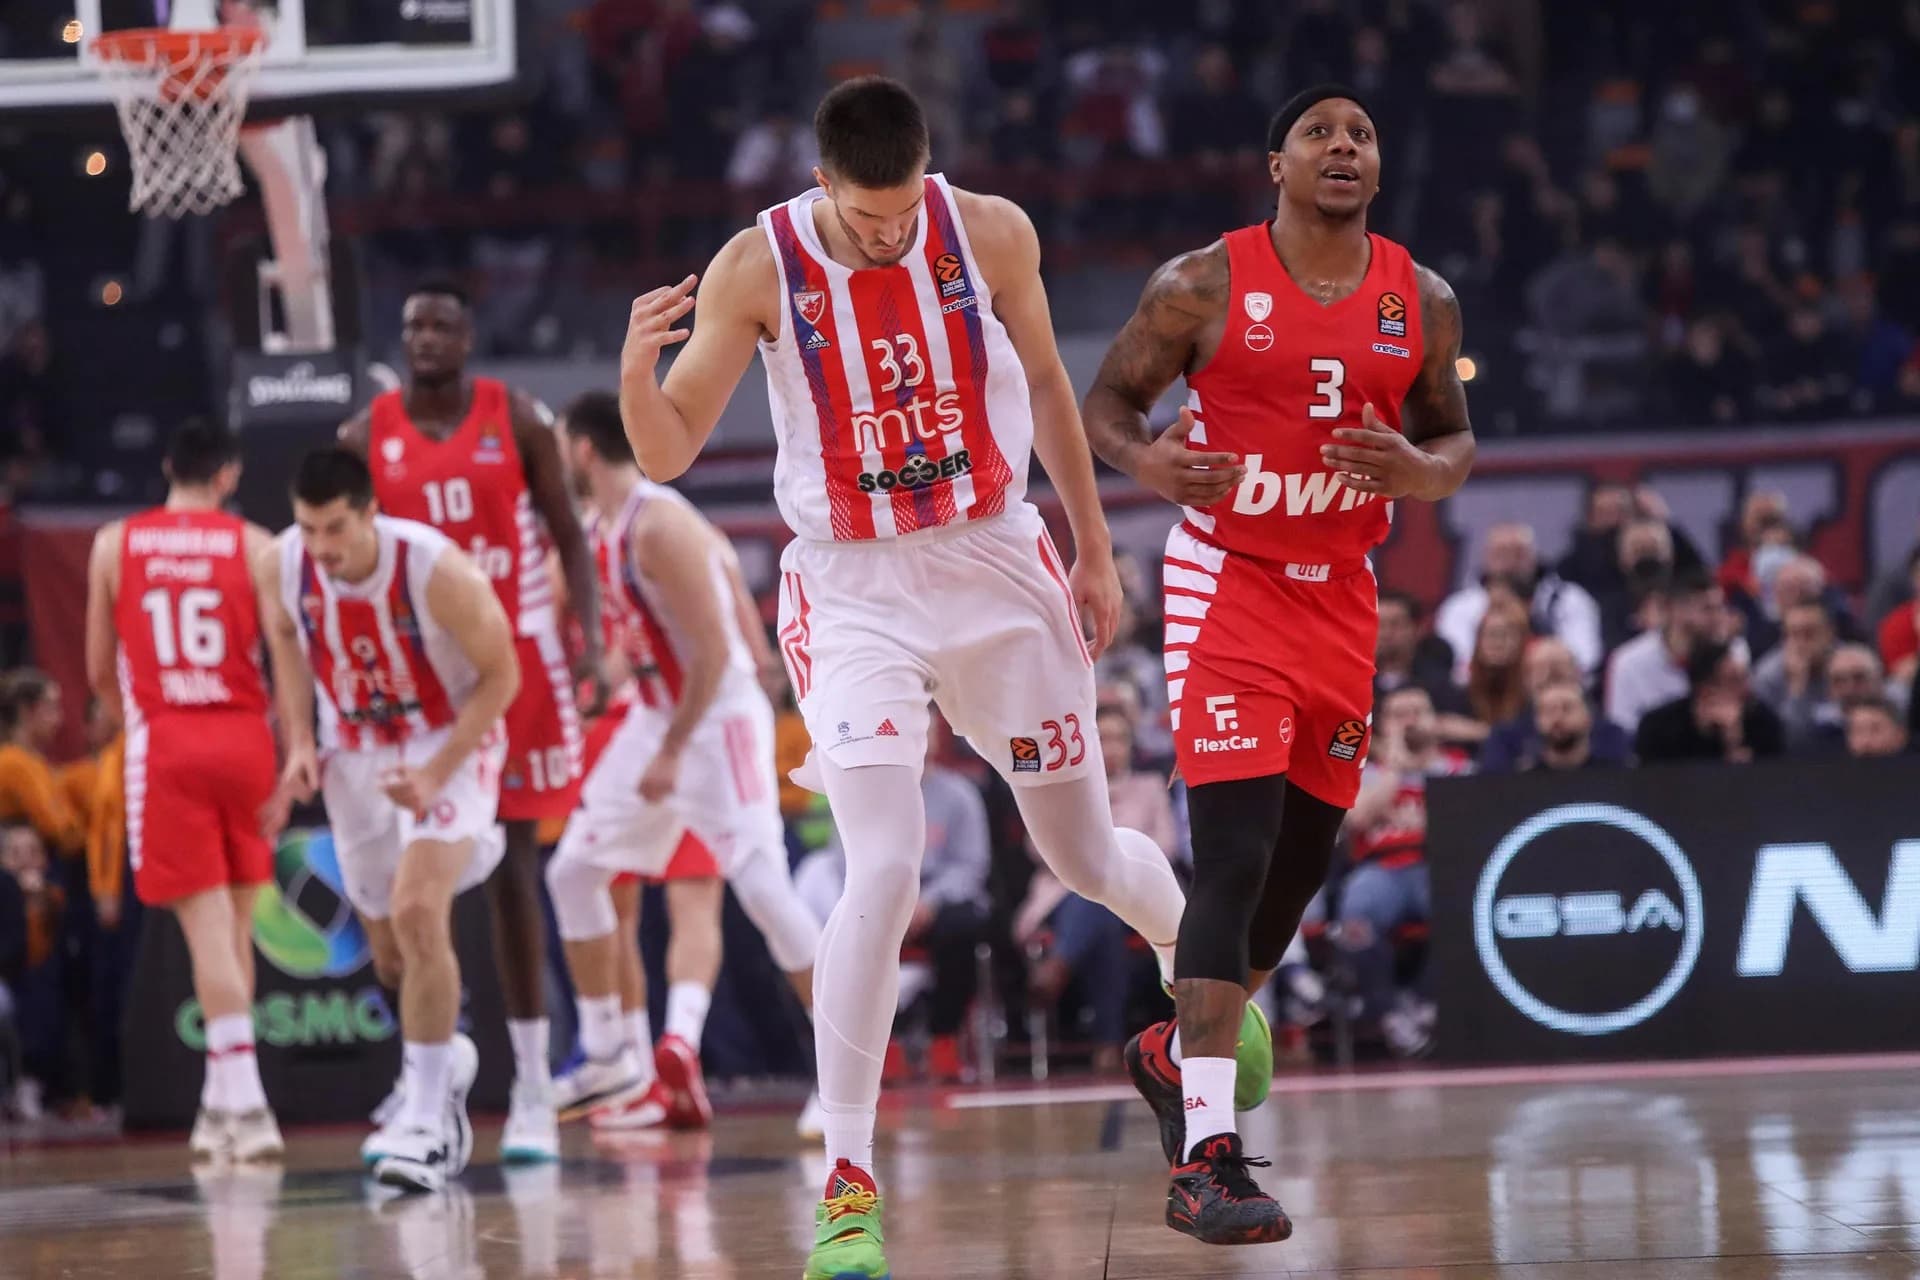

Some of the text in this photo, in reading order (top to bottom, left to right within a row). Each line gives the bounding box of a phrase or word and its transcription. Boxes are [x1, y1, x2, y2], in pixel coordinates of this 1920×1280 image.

[806, 340, 830, 349] adidas
[872, 334, 925, 392] 33
[1309, 358, 1345, 418] 3
[851, 394, 963, 452] mts
[857, 450, 973, 492] SOCCER
[1232, 454, 1376, 516] bwi
[422, 477, 474, 525] 10
[142, 586, 225, 668] 16
[527, 745, 568, 792] 10
[1041, 713, 1085, 771] 33
[1194, 736, 1258, 753] FlexCar
[1737, 838, 1920, 977] N
